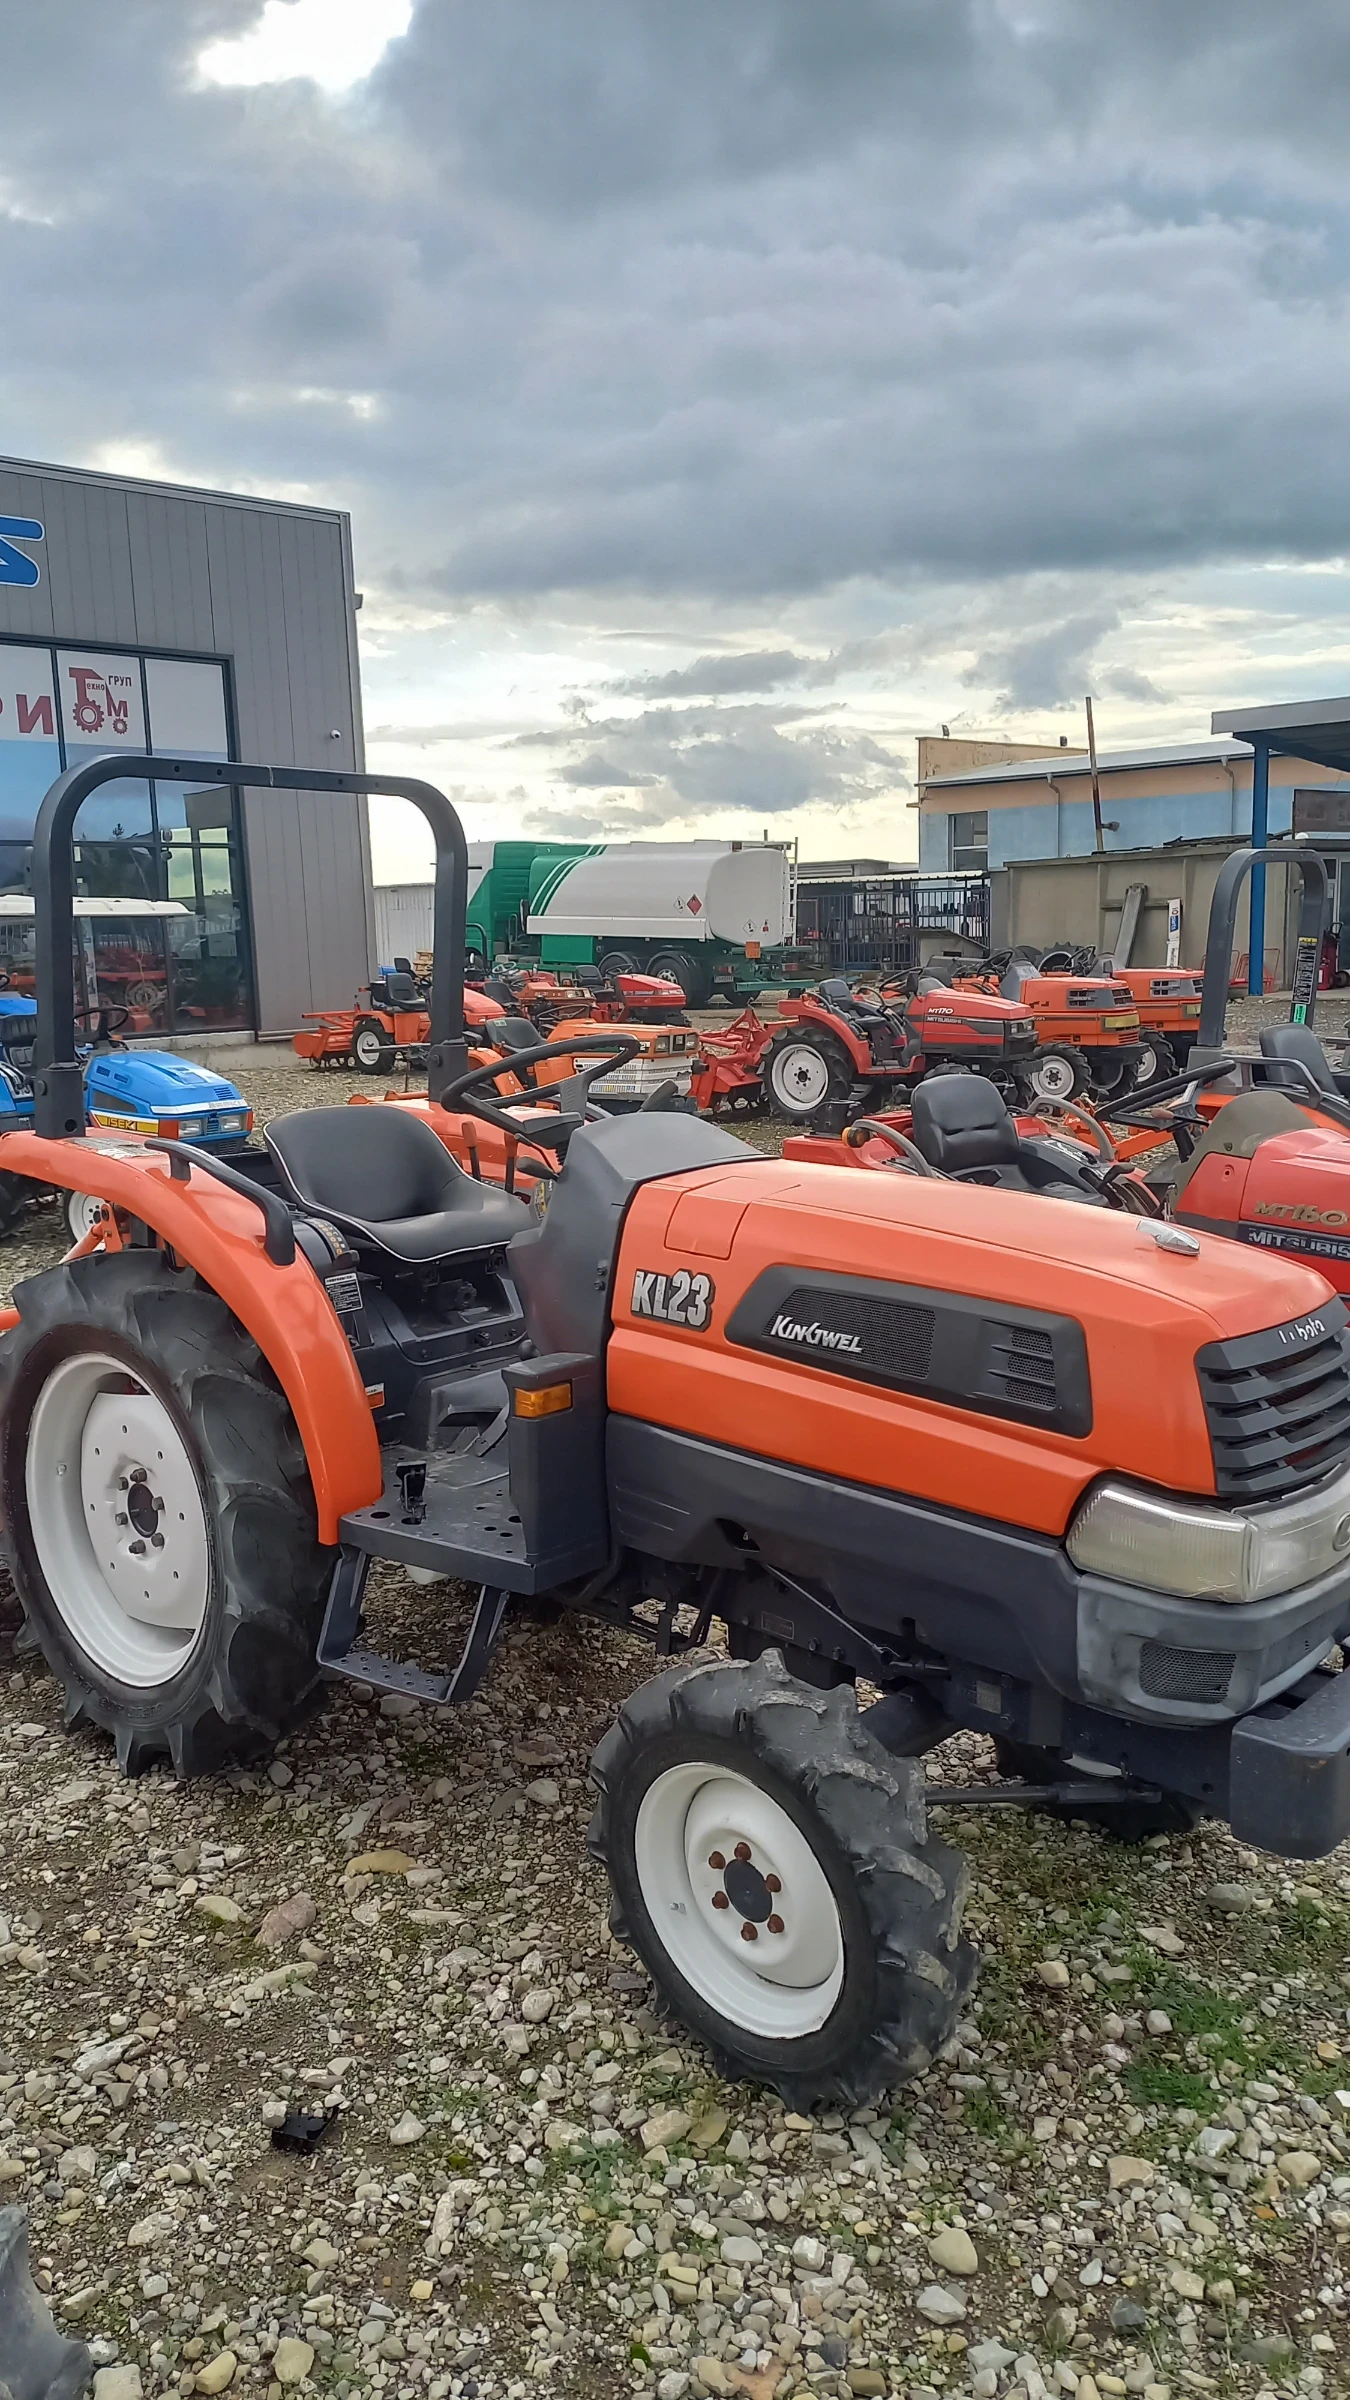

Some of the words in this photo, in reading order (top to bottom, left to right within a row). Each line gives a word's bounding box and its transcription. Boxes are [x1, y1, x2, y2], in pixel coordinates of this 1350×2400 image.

[108, 675, 132, 687] ГРУП
[0, 694, 54, 735] И
[107, 1117, 137, 1131] ISEKI
[1254, 1201, 1349, 1227] MT160
[631, 1269, 713, 1329] KL23
